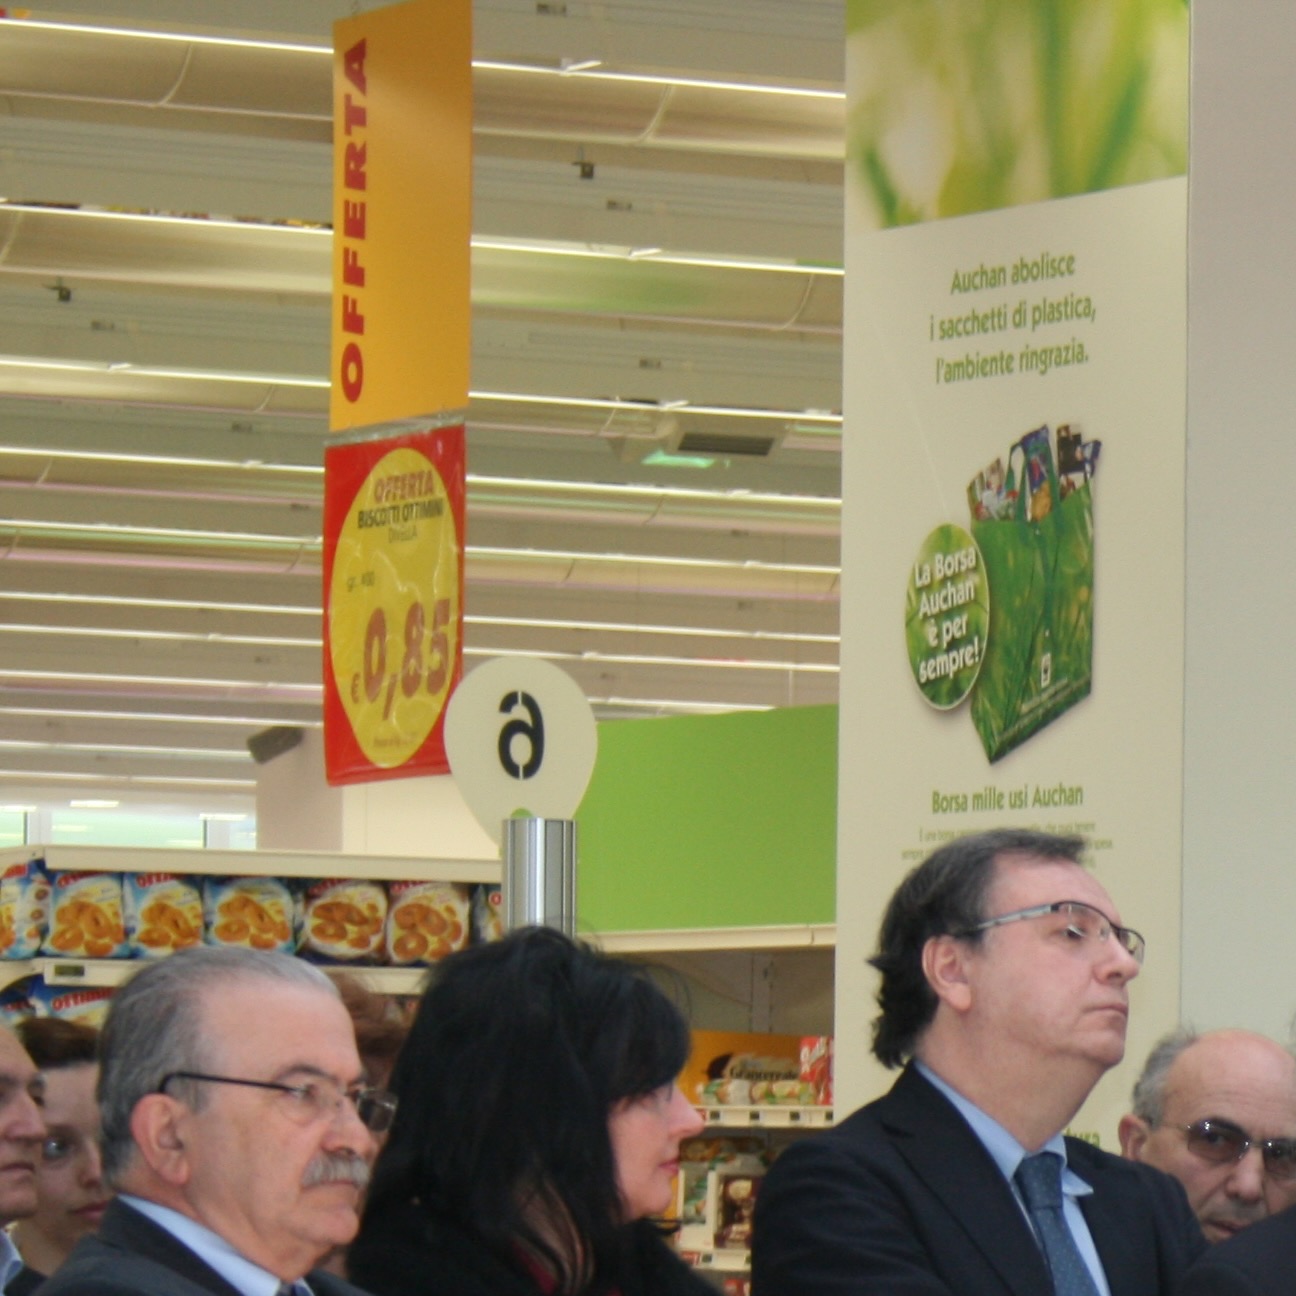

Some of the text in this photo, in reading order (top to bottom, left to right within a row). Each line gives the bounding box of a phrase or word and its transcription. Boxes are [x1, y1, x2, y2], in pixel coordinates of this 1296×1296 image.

[341, 37, 367, 403] OFFERTA
[950, 252, 1075, 295] Auchan abolisce
[929, 293, 1096, 341] i sacchetti di plastica,
[936, 337, 1089, 384] l'ambiente ringrazia.
[375, 470, 433, 503] OFFERTA
[358, 505, 400, 529] BISCOTTI
[915, 547, 976, 588] La Borsa
[919, 580, 975, 619] Auchan
[928, 613, 968, 649] è per
[919, 635, 979, 684] sempre!
[932, 782, 1083, 813] Borsa mille usi Auchan
